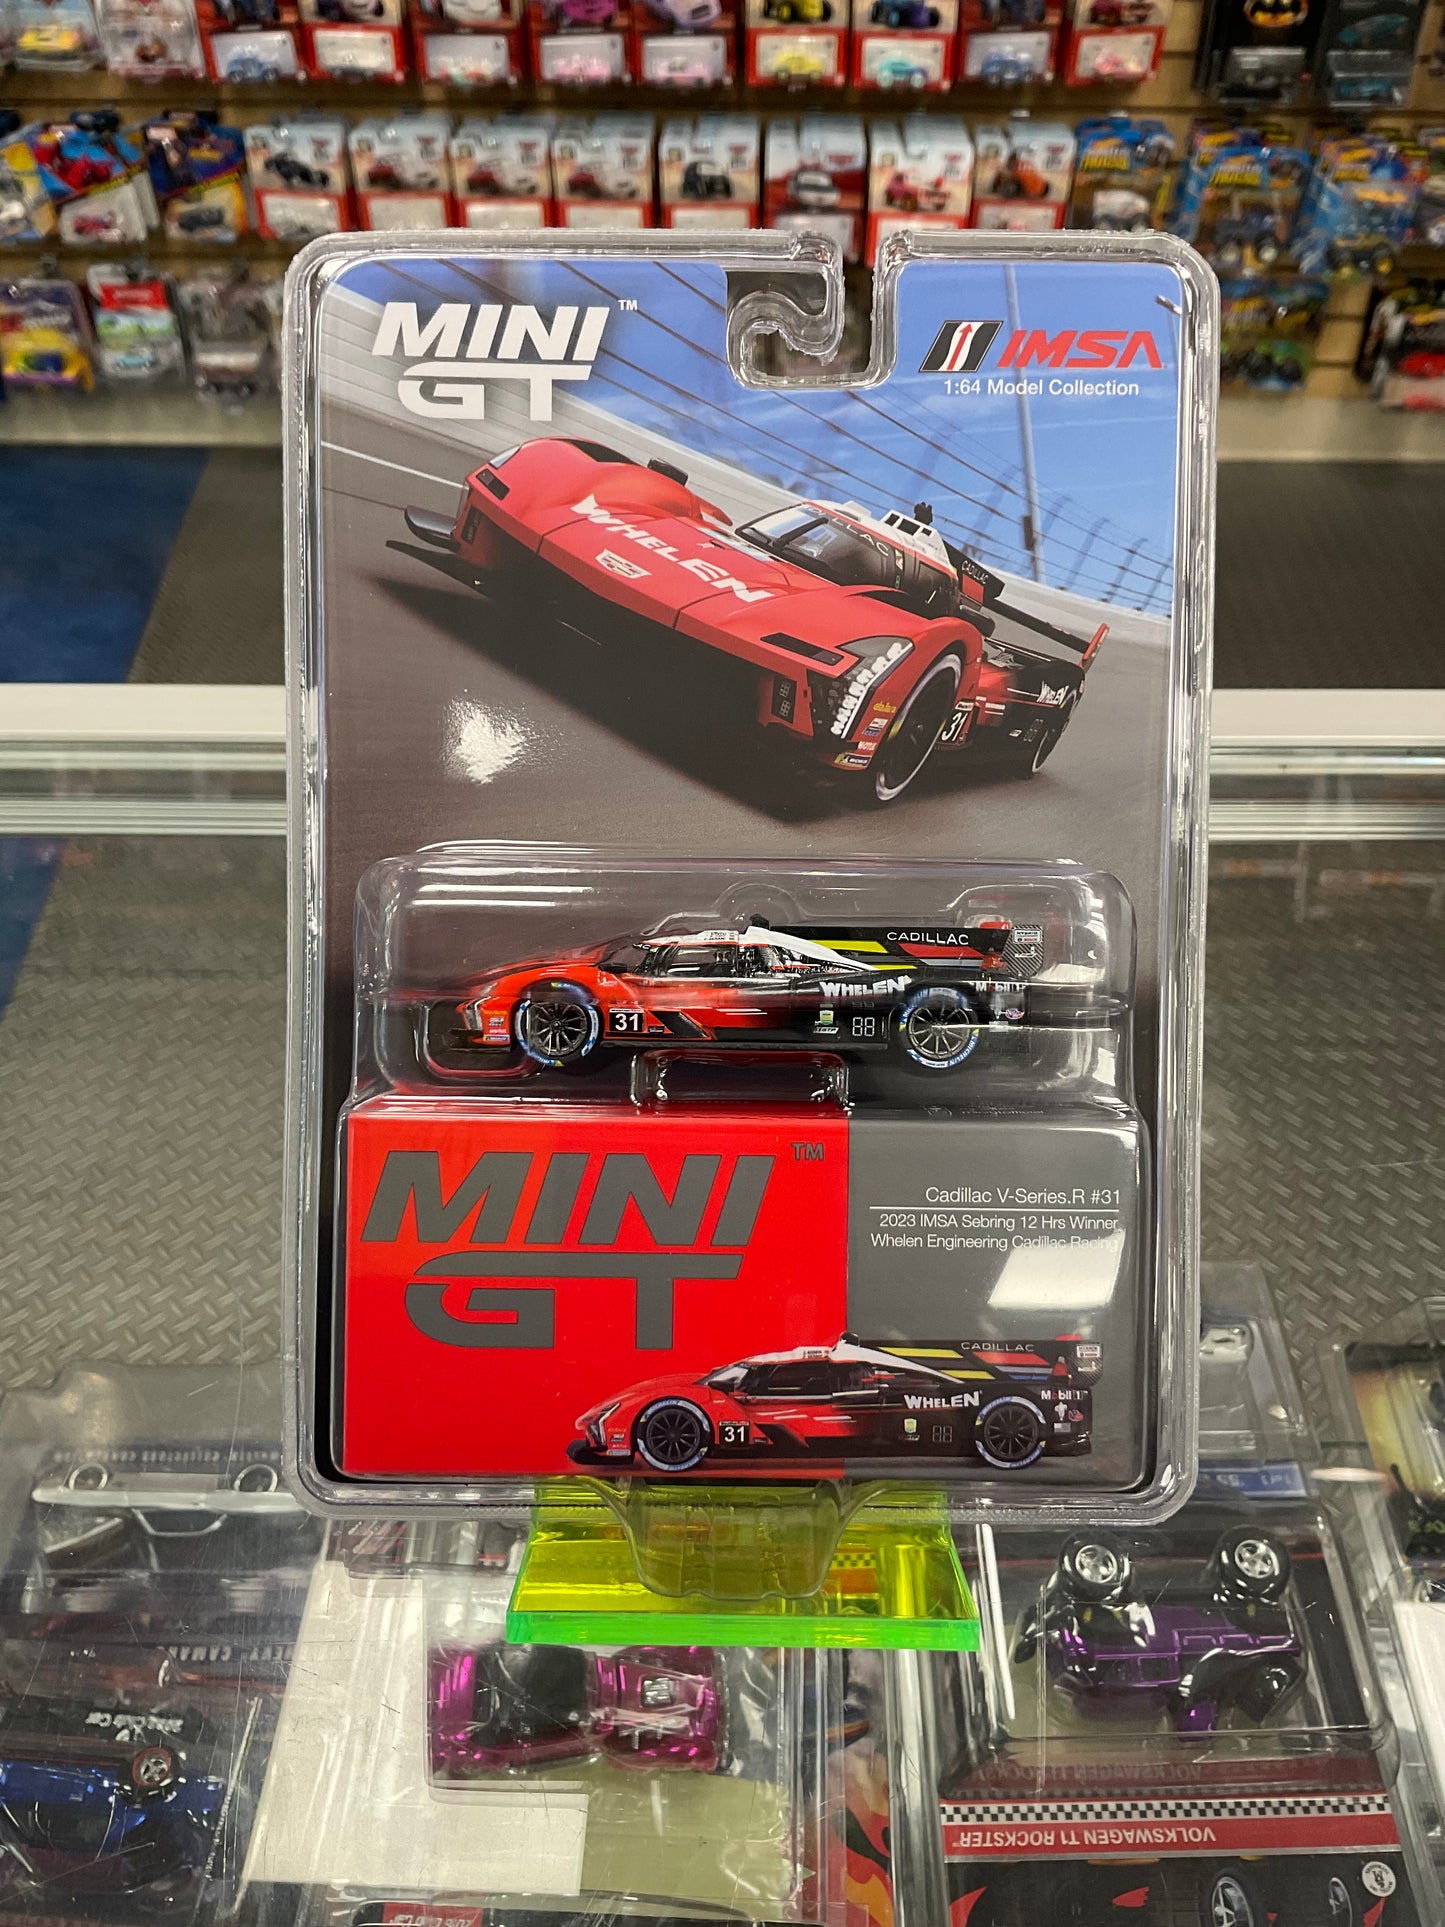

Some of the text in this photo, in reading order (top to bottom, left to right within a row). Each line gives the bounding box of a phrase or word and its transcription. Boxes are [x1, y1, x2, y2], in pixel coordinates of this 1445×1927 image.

[372, 302, 610, 361] MINI
[996, 329, 1163, 369] IMSA
[397, 361, 592, 421] GT
[944, 378, 1140, 396] 1:64 Model Collection
[570, 493, 775, 603] WHELEN
[941, 711, 967, 742] 31
[886, 931, 969, 946] CADILLAC
[819, 975, 910, 998] WHELEN
[614, 1013, 640, 1031] 31
[361, 1150, 776, 1247] MINI
[925, 1186, 1121, 1205] Cadillac V-Series.R #31
[880, 1213, 1119, 1231] 2023 IMSA Sebring 12 Hrs Winner
[871, 1233, 923, 1248] Whelen
[927, 1234, 1008, 1251] Engineering
[1012, 1235, 1067, 1249] Cadillac
[405, 1250, 744, 1350] GT
[961, 1341, 1035, 1352] CADILLAC
[903, 1391, 980, 1409] WHELEN
[1041, 1389, 1072, 1400] Mobil
[724, 1425, 745, 1442] 31
[960, 1826, 1216, 1847] VOLKSWAGEN T1 ROCKSTER
